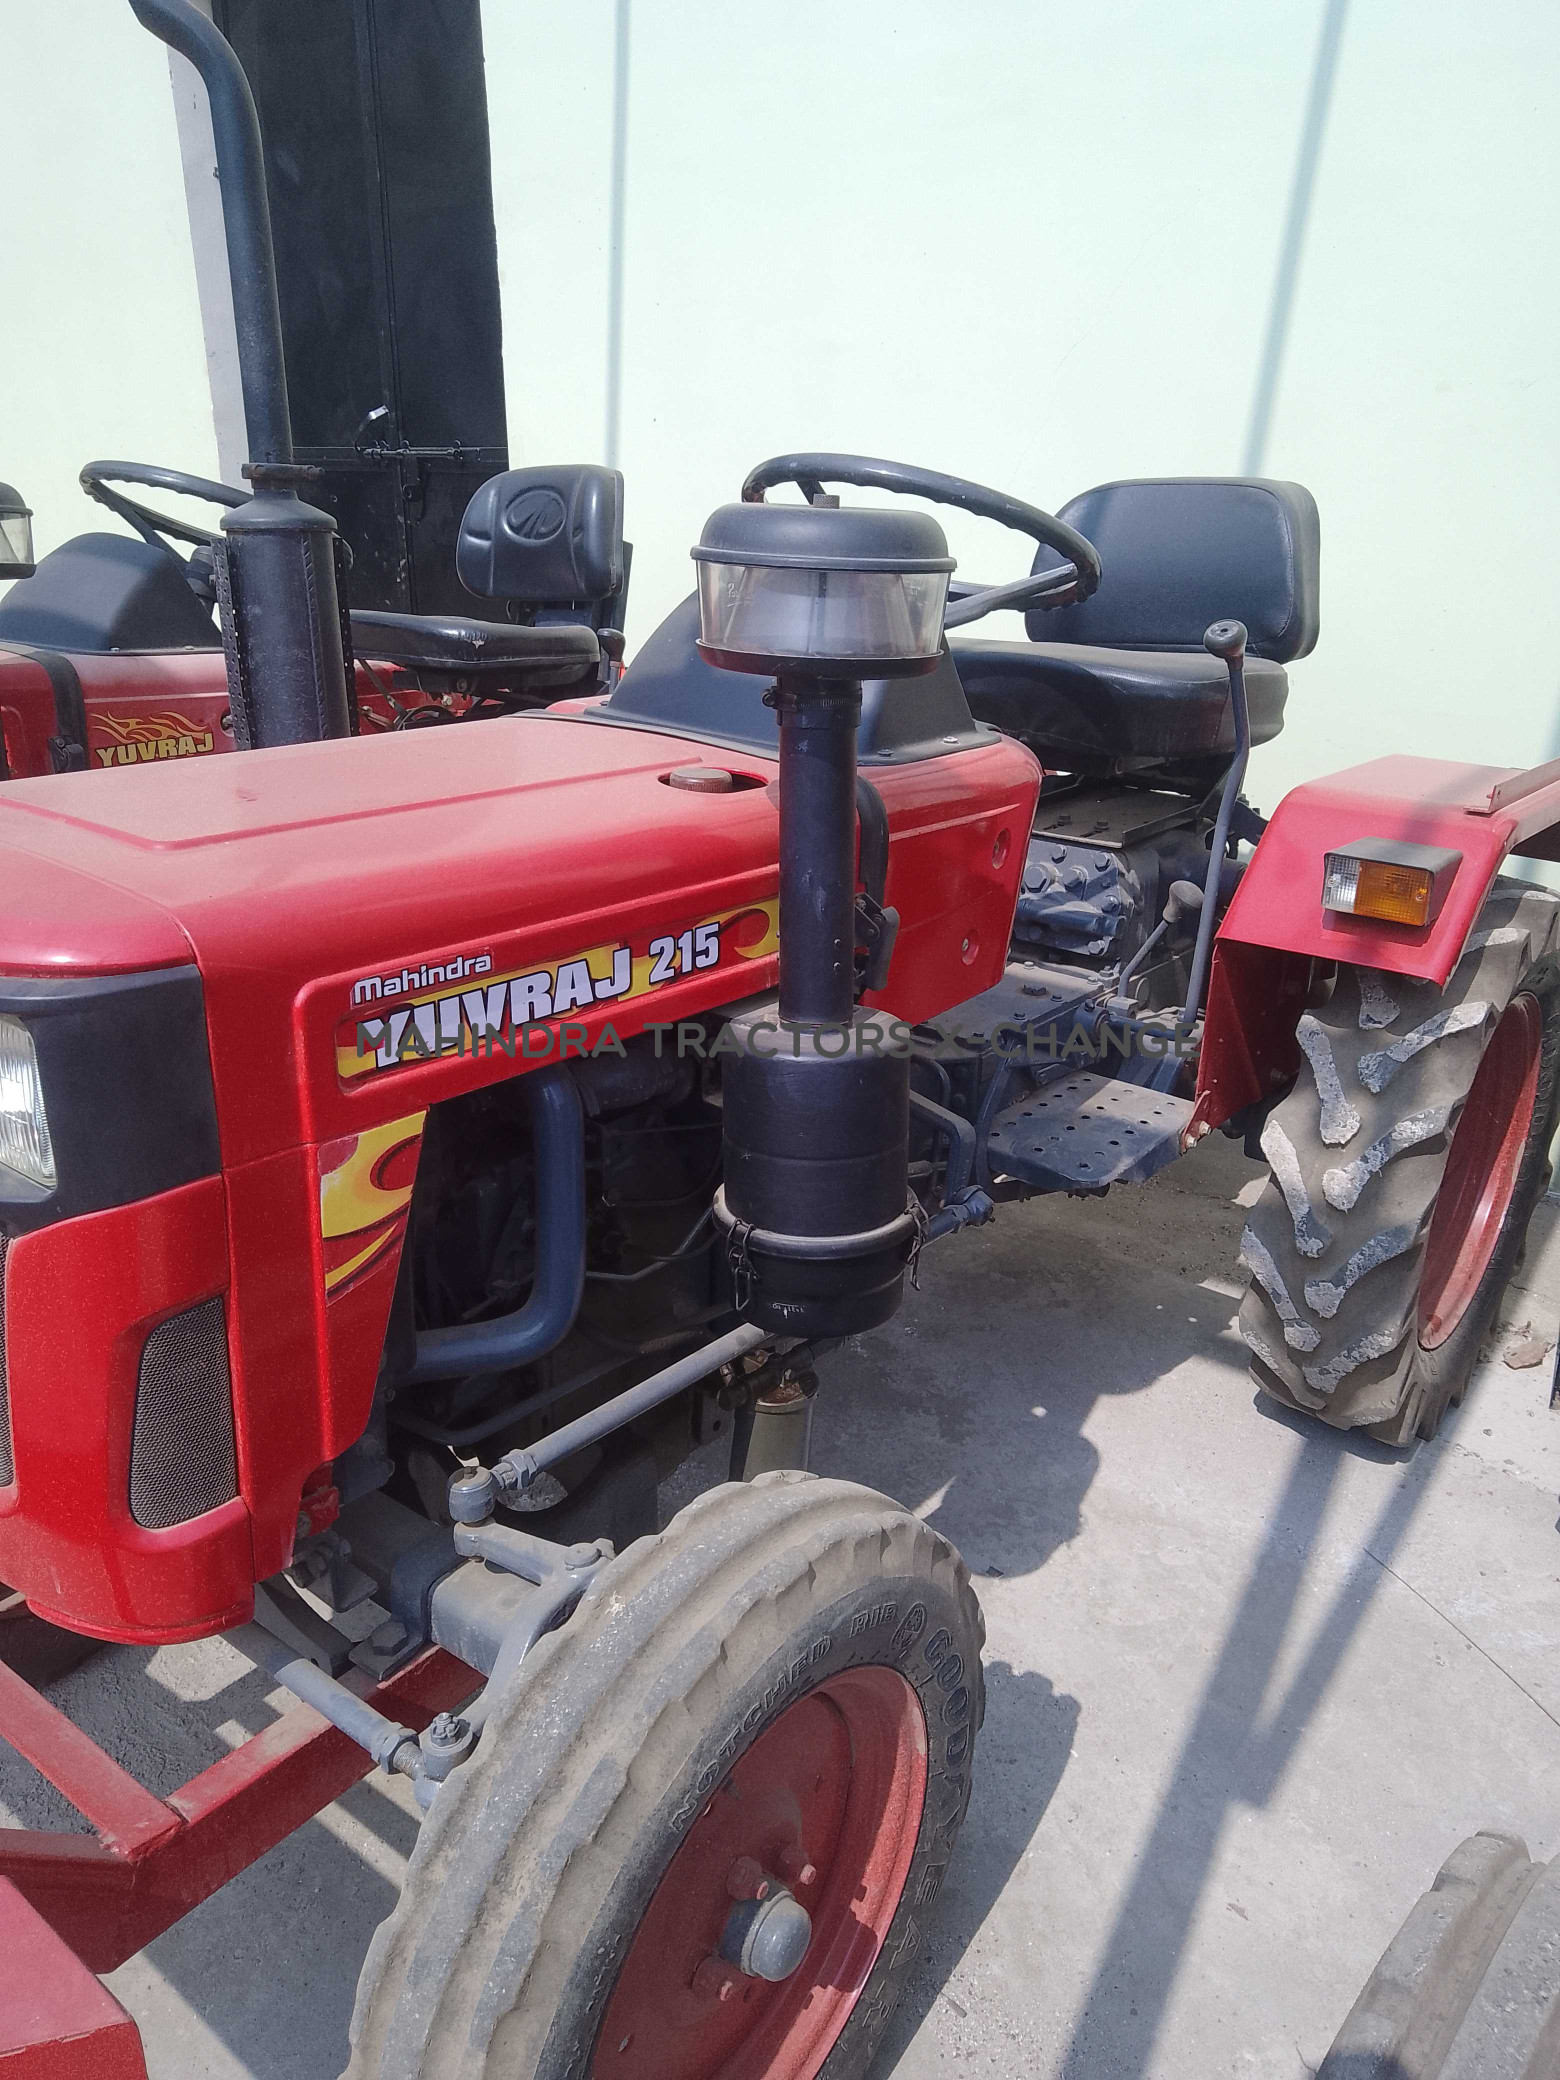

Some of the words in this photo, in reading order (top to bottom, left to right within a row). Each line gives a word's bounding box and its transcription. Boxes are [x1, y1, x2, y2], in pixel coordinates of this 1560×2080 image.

[96, 732, 214, 767] YUVRAJ
[354, 953, 493, 1004] Mahindra
[360, 947, 633, 1069] YUVRAJ
[648, 921, 722, 984] 215
[670, 1636, 832, 1832] NOTCHED
[850, 1603, 897, 1638] RIB
[861, 1627, 970, 2032] GOODYEAR
